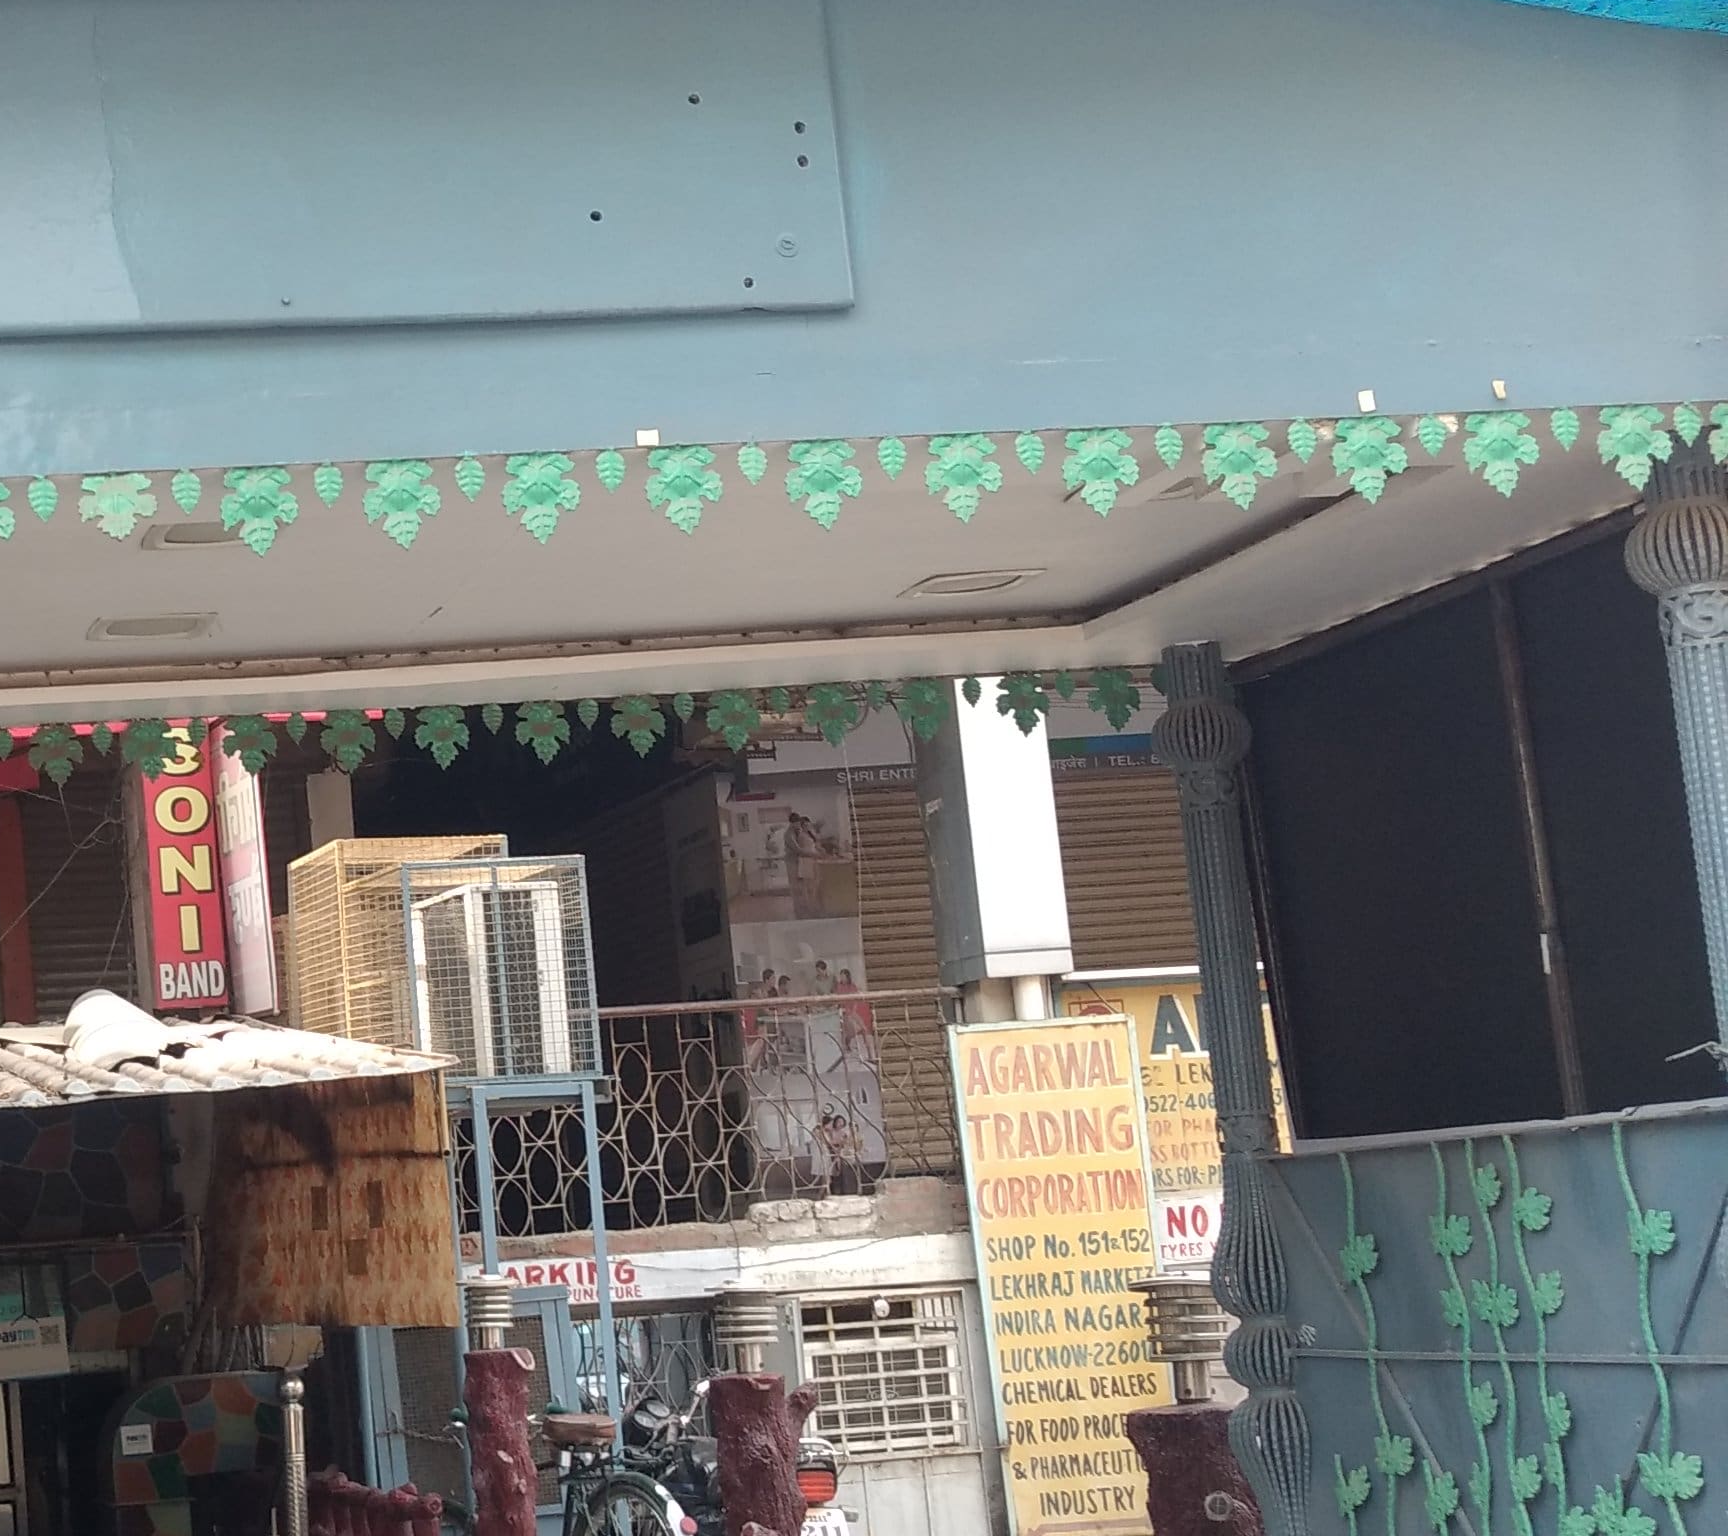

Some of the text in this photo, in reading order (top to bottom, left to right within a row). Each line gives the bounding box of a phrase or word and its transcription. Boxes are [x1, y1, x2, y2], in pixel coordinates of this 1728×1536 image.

[158, 959, 225, 1001] BAND
[966, 1038, 1129, 1097] AGARWAL
[966, 1104, 1135, 1161] TRADING
[975, 1168, 1147, 1220] CORPORATION
[1166, 1204, 1209, 1238] NO
[986, 1234, 1036, 1263] SHOP
[479, 1258, 636, 1288] ARKING
[989, 1270, 1076, 1302] LEKHRAJ
[995, 1308, 1057, 1337] INDIRA
[1001, 1372, 1158, 1406] CHEMICAL DEALERS
[1040, 1416, 1080, 1443] FOOD
[1011, 1460, 1028, 1481] &
[1039, 1485, 1136, 1518] INDUSTRY
